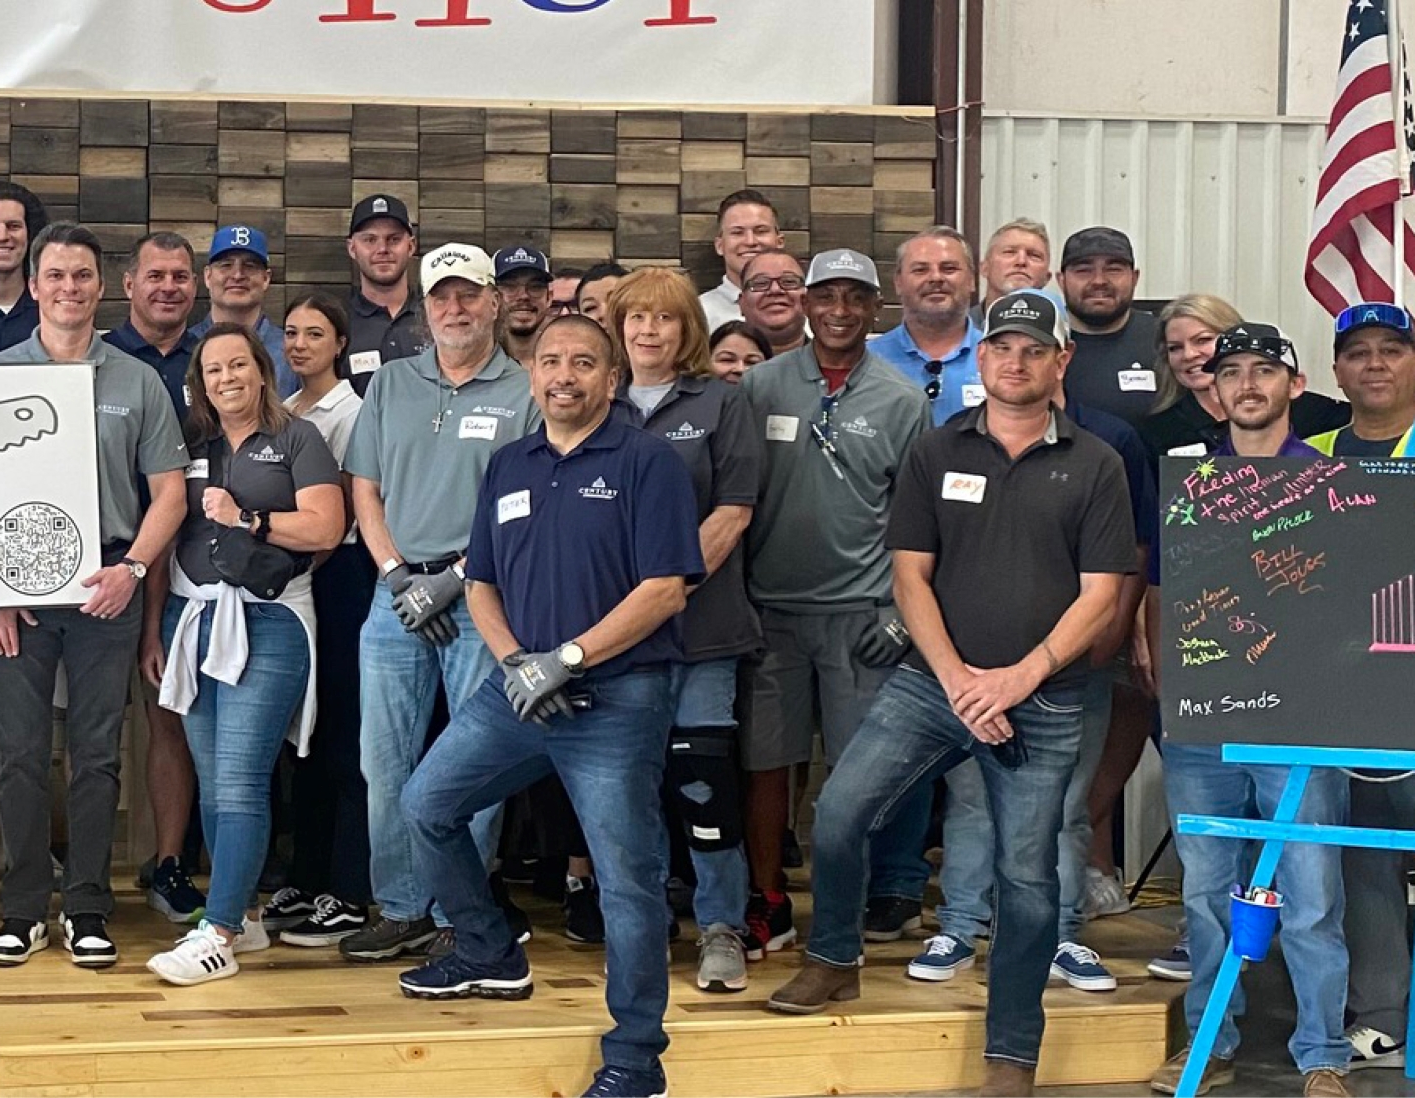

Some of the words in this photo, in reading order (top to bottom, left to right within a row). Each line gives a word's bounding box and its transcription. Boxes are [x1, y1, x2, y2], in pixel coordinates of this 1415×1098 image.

[230, 226, 250, 246] B
[999, 309, 1041, 318] CENTURY
[465, 420, 494, 431] Robert
[665, 429, 705, 437] CENTURY
[248, 452, 284, 460] CENTURY
[950, 478, 983, 496] RAY
[1184, 464, 1261, 500] Feeding
[578, 487, 618, 496] CENTURY
[1200, 491, 1238, 518] the
[1178, 699, 1214, 717] Max
[1220, 690, 1282, 713] Sands
